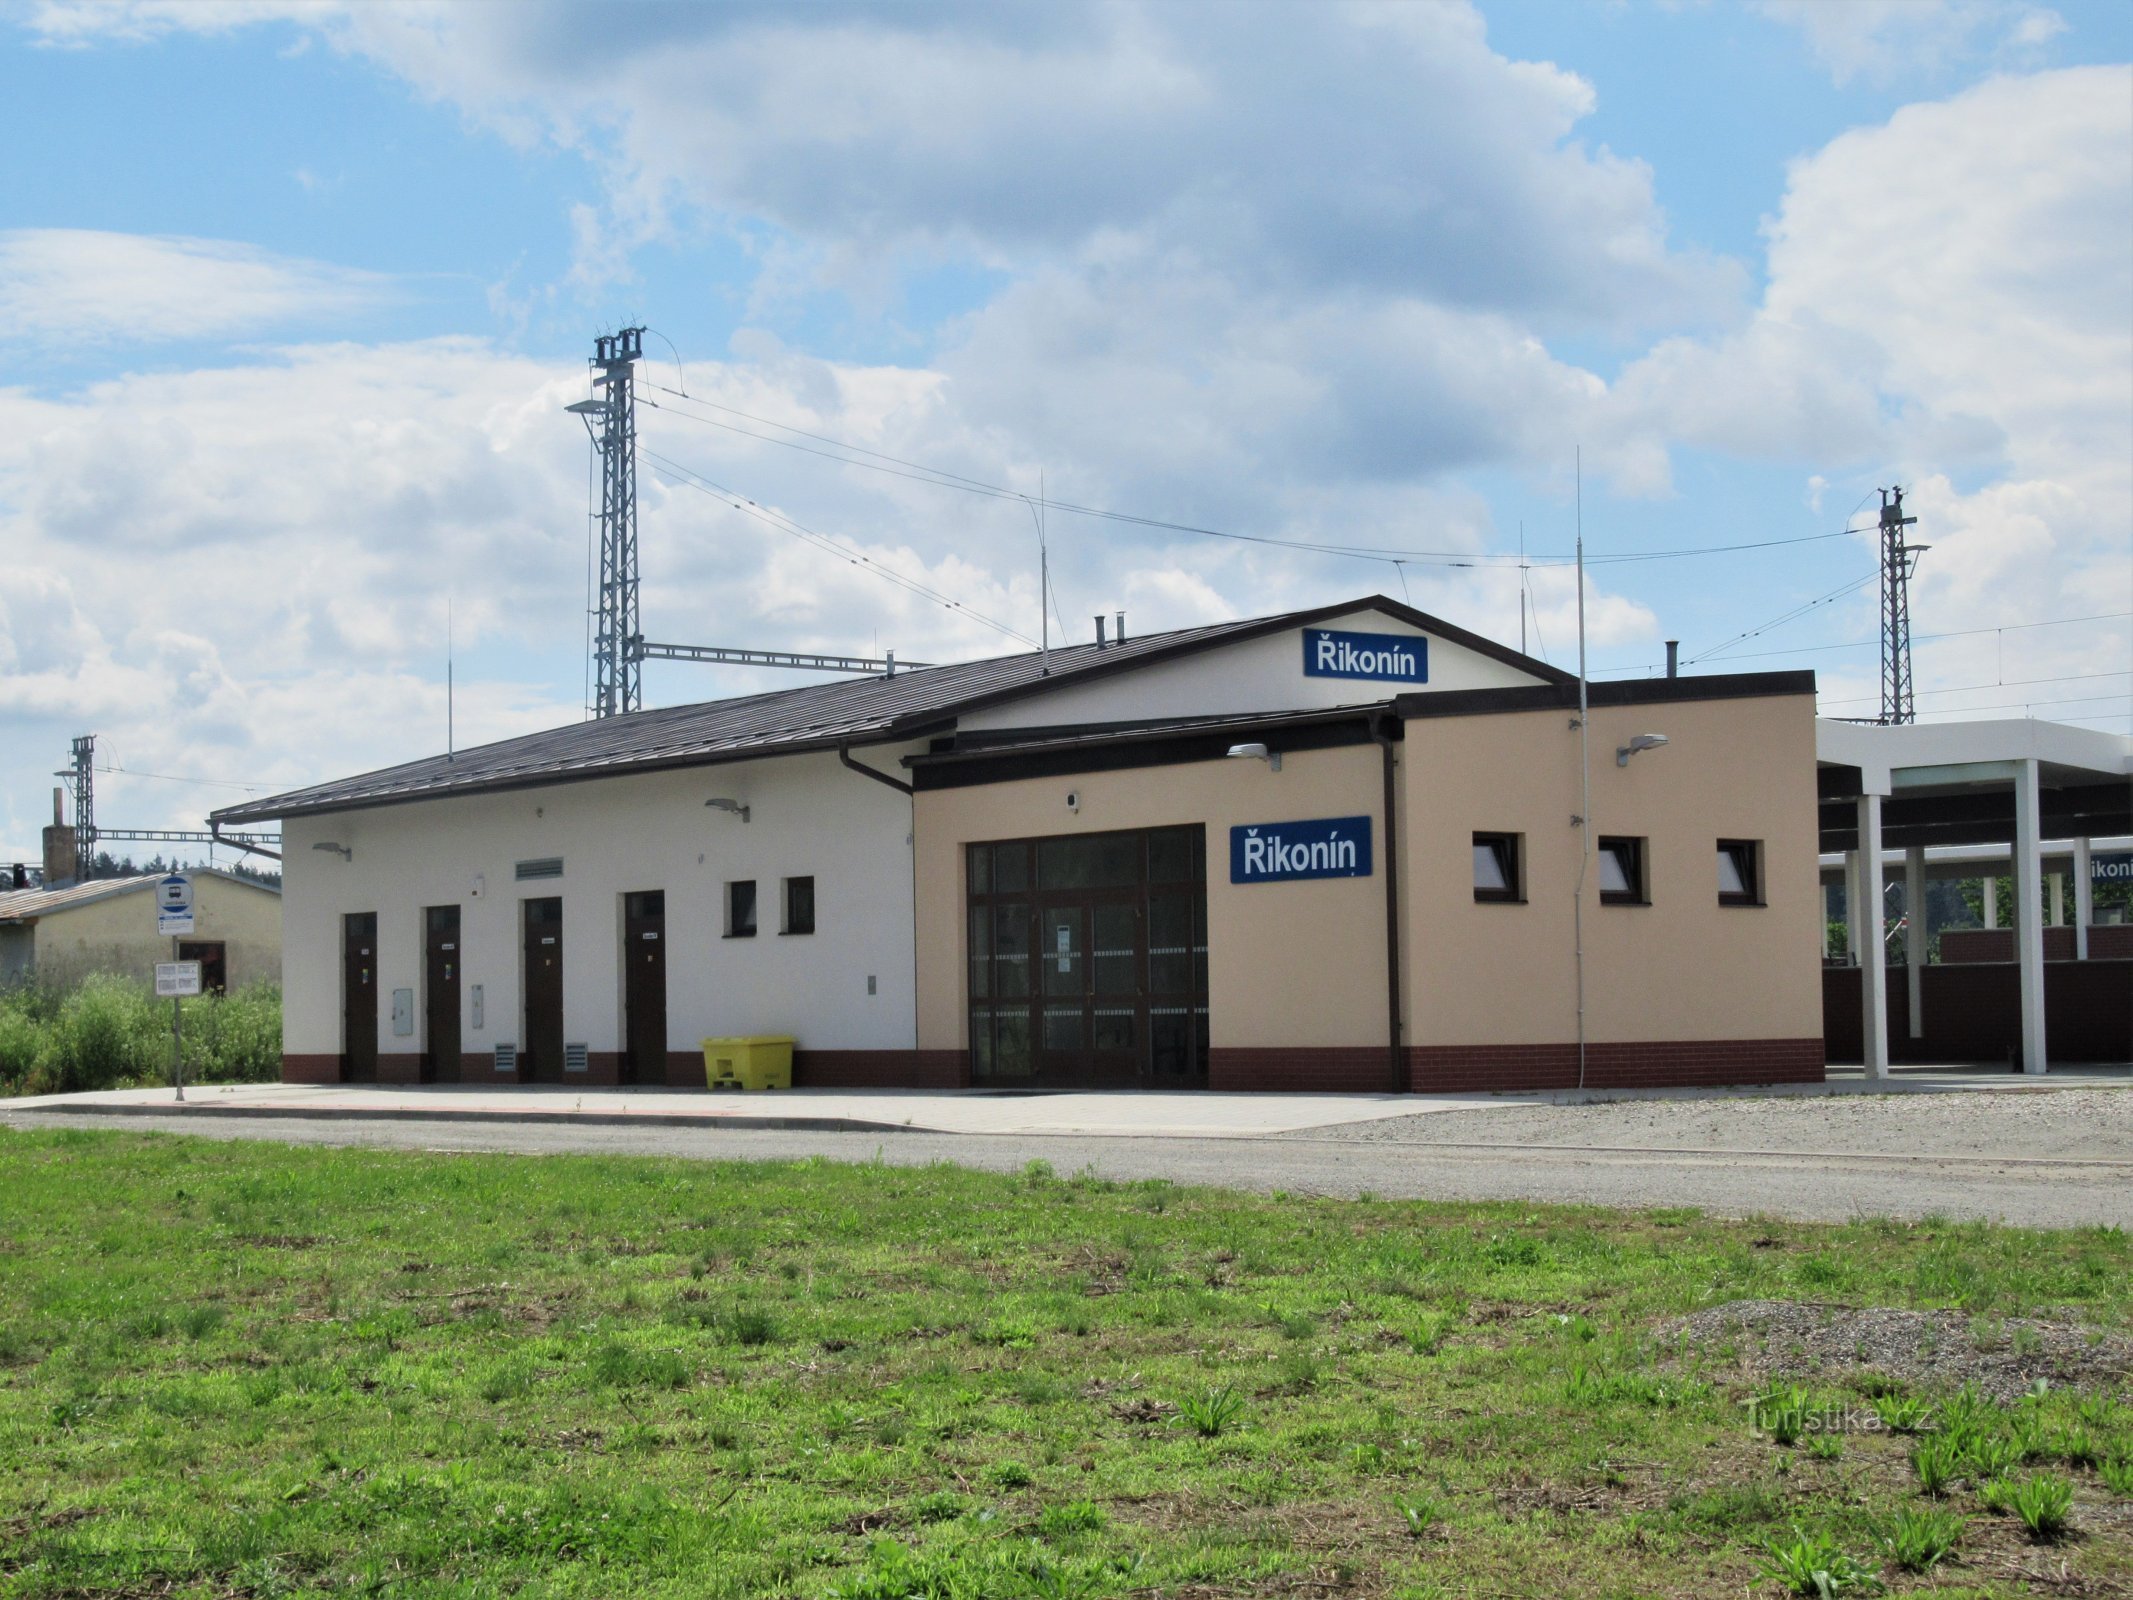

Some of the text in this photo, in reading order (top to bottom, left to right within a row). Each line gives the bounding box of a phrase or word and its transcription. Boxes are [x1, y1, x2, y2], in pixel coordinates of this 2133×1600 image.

[1317, 633, 1415, 675] Řikonín
[1244, 828, 1356, 874] Řikonín
[2091, 858, 2133, 877] ikoní
